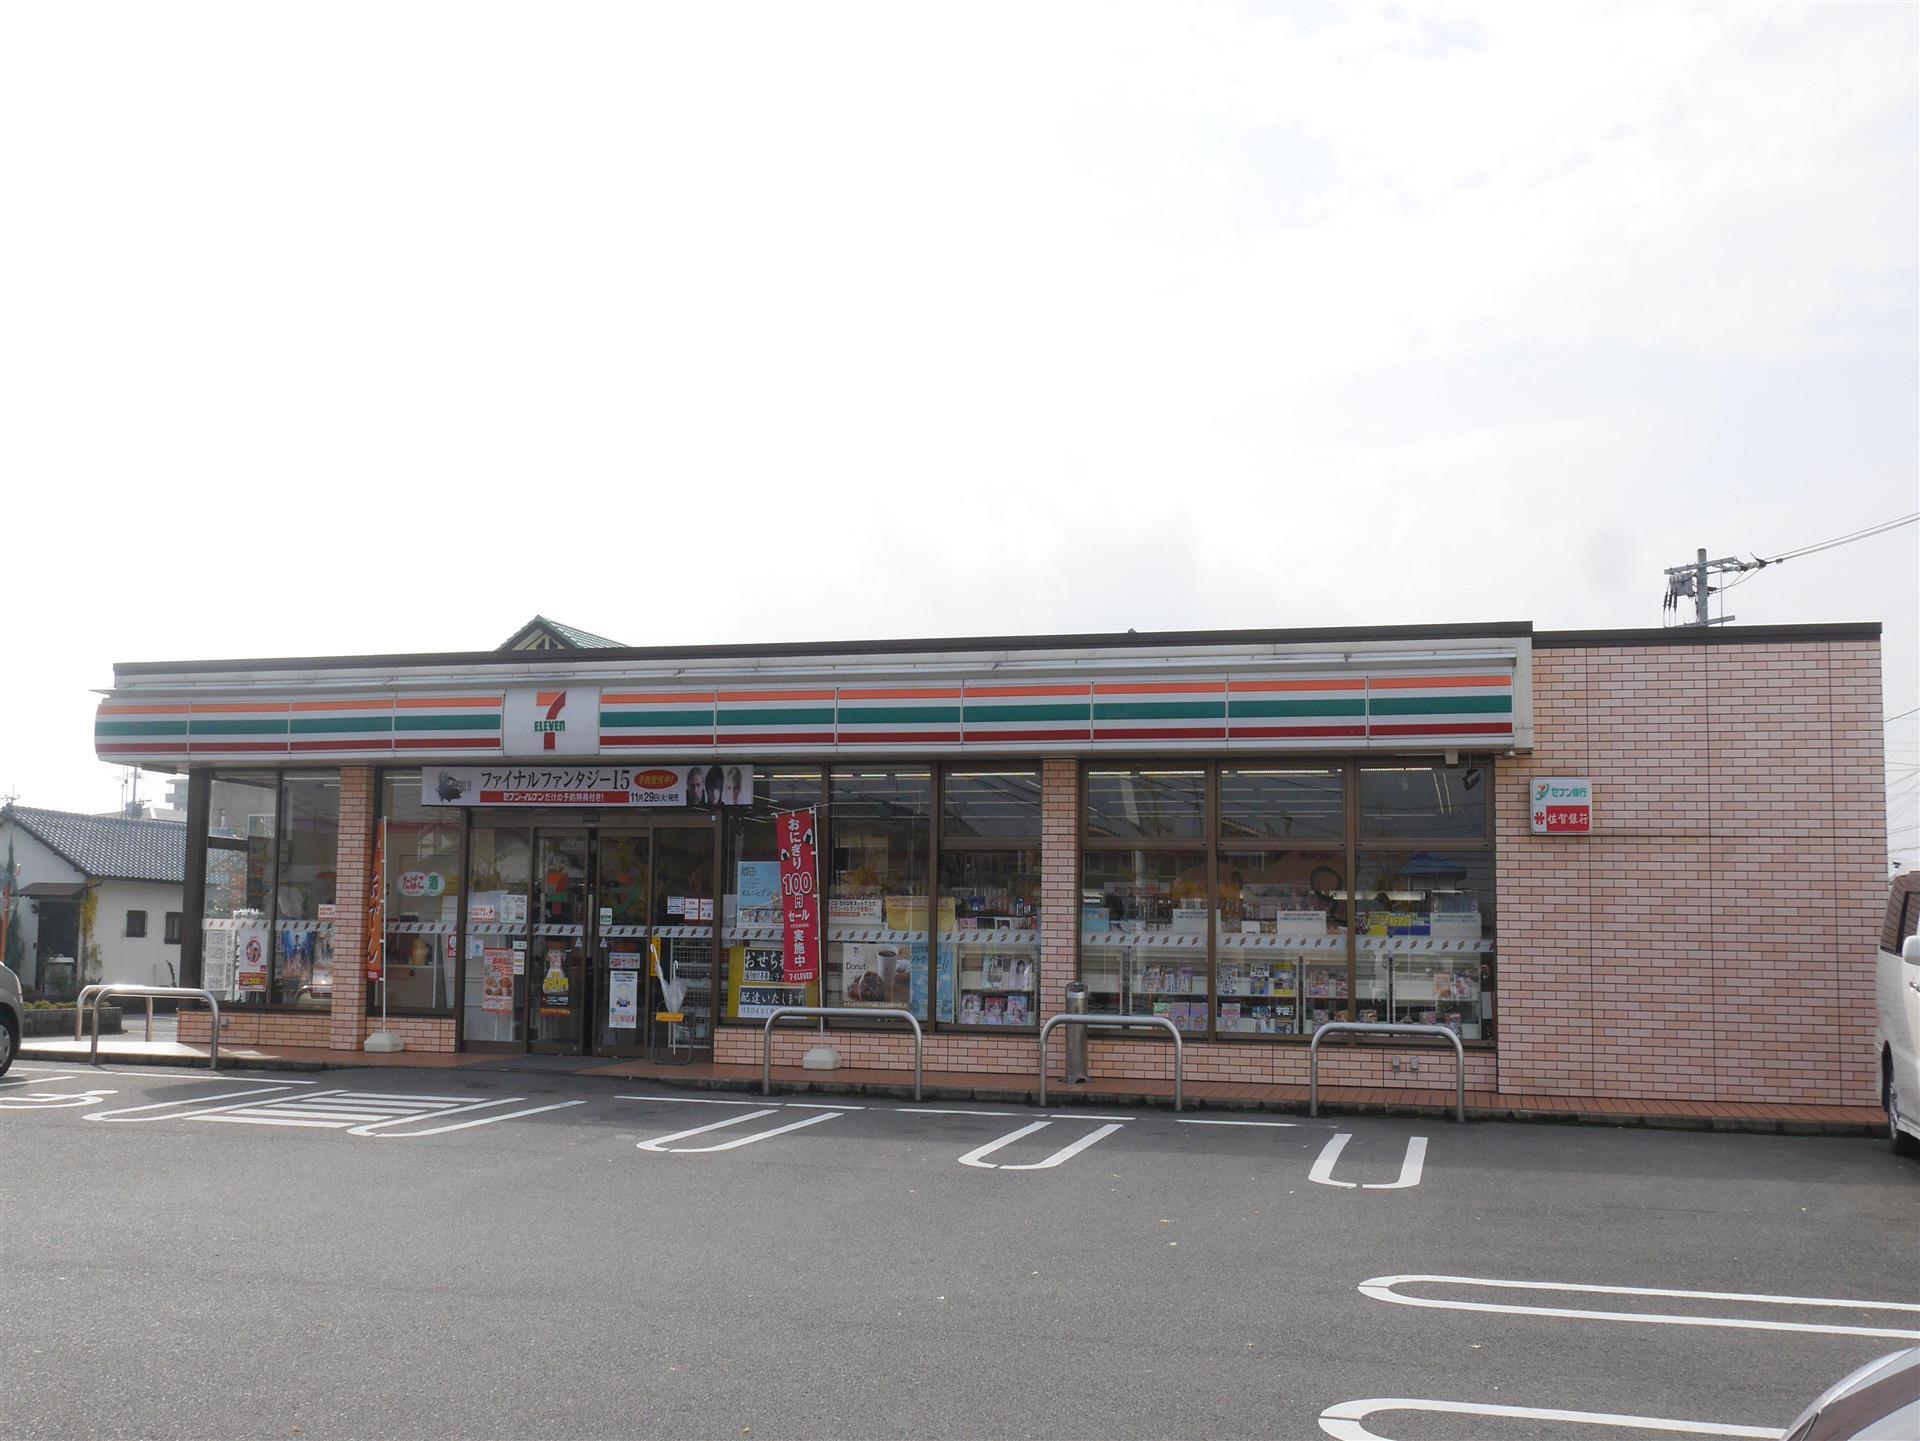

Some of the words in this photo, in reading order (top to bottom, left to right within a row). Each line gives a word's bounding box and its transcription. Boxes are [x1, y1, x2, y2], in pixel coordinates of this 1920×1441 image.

[536, 692, 566, 750] 7
[480, 769, 631, 790] ファイナルファンタジー15
[1551, 787, 1587, 798] セブン銀行
[1547, 813, 1589, 825] 佐賀銀行
[788, 818, 802, 870] おにぎり
[402, 875, 425, 890] たばこ
[788, 909, 810, 922] セール
[793, 929, 807, 968] 実施中
[845, 962, 866, 971] Donut
[740, 991, 805, 1005] 配達いたします
